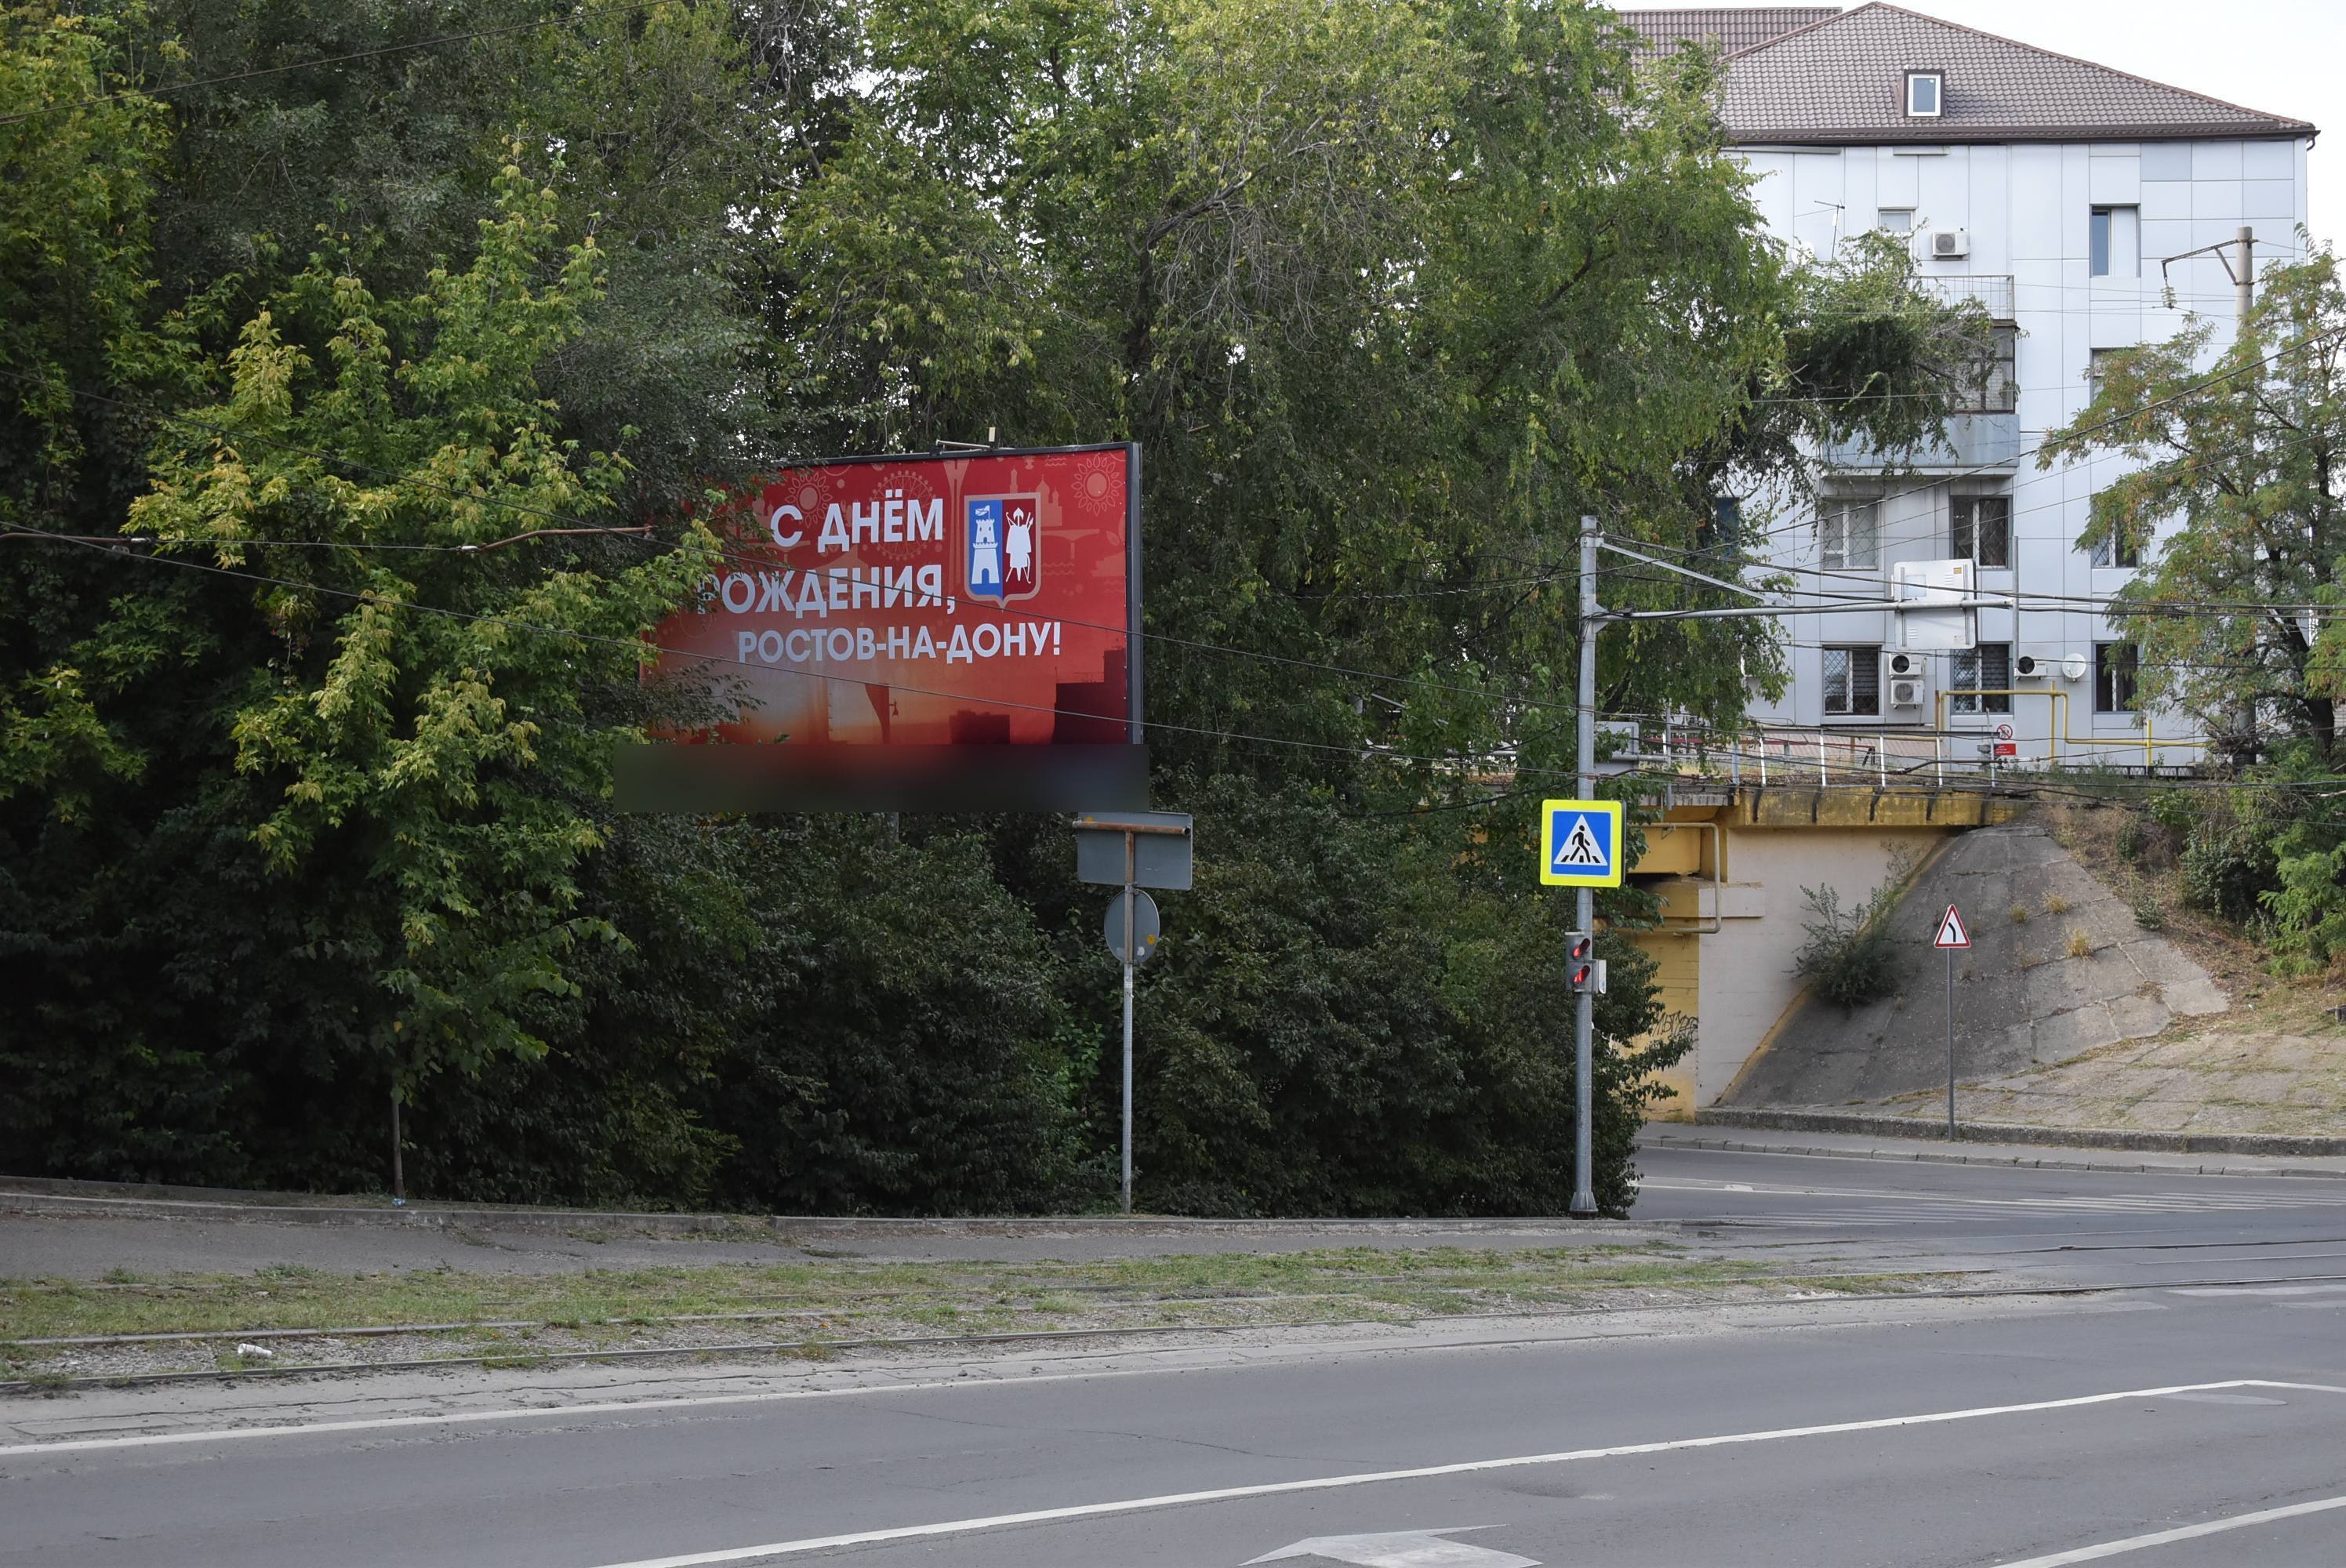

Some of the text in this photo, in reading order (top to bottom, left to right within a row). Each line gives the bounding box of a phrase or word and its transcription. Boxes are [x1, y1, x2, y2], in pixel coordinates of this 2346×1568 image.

[770, 489, 943, 553] С ДНЁМ
[739, 622, 1062, 663] РОСТОВ-НА-ДОНУ!
